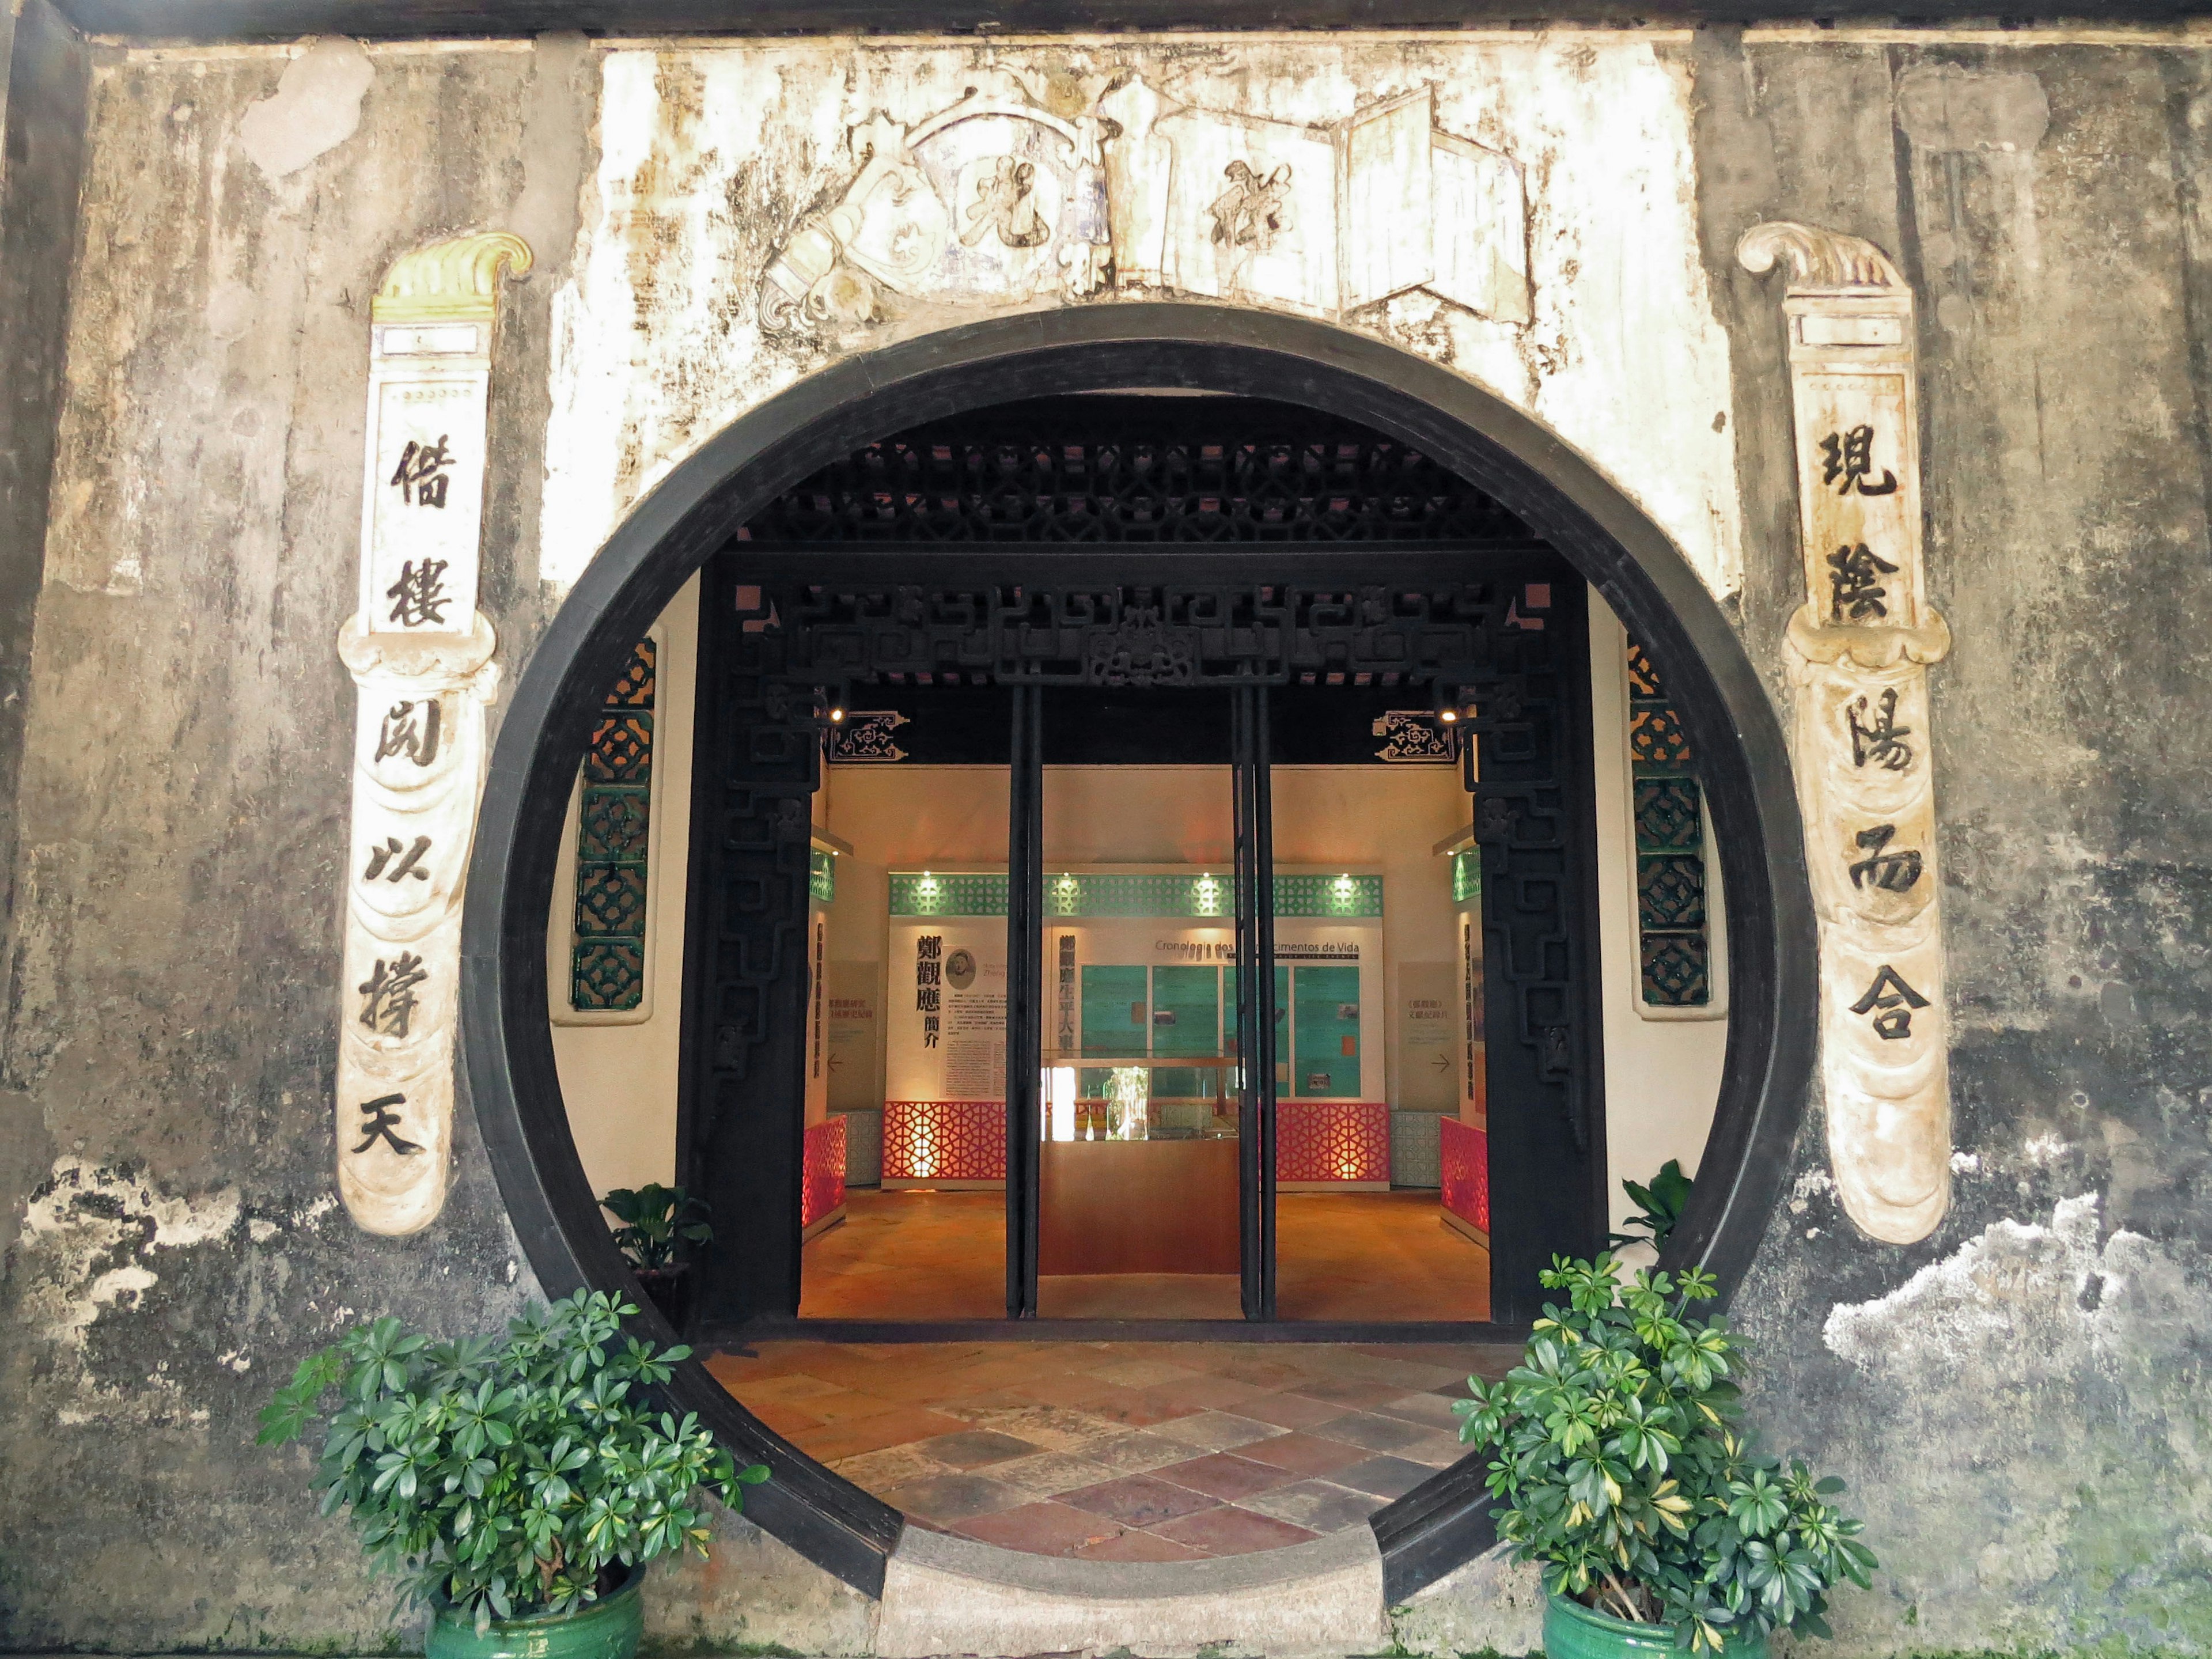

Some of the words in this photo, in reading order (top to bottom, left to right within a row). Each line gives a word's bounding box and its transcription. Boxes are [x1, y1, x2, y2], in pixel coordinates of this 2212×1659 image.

[1156, 940, 1211, 953] Cronologia
[1215, 941, 1233, 950] dos
[1274, 941, 1319, 952] cimentos
[1322, 942, 1335, 952] de
[1336, 942, 1359, 952] Vida
